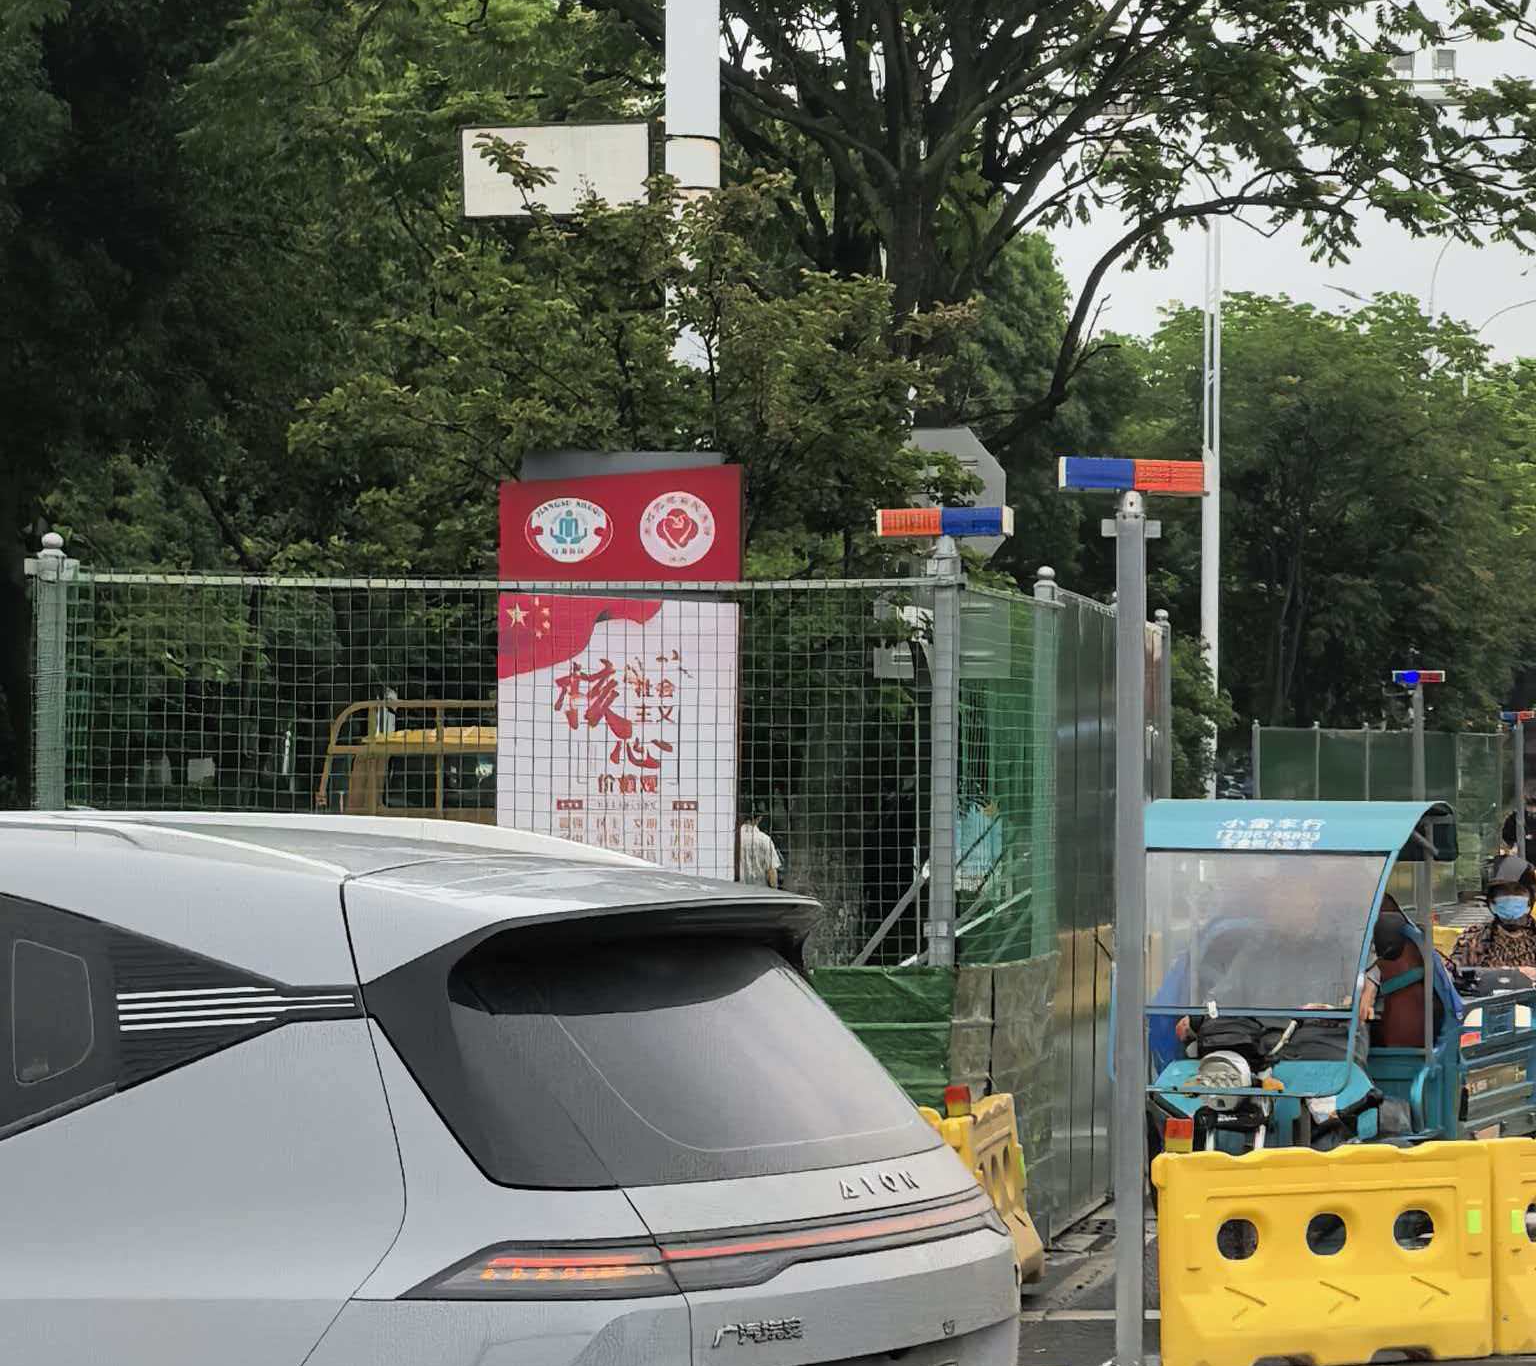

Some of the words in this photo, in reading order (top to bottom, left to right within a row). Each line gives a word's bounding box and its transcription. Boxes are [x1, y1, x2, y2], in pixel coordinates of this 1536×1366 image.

[634, 703, 676, 724] 主义
[597, 773, 659, 794] 价值观
[838, 1170, 920, 1201] AION
